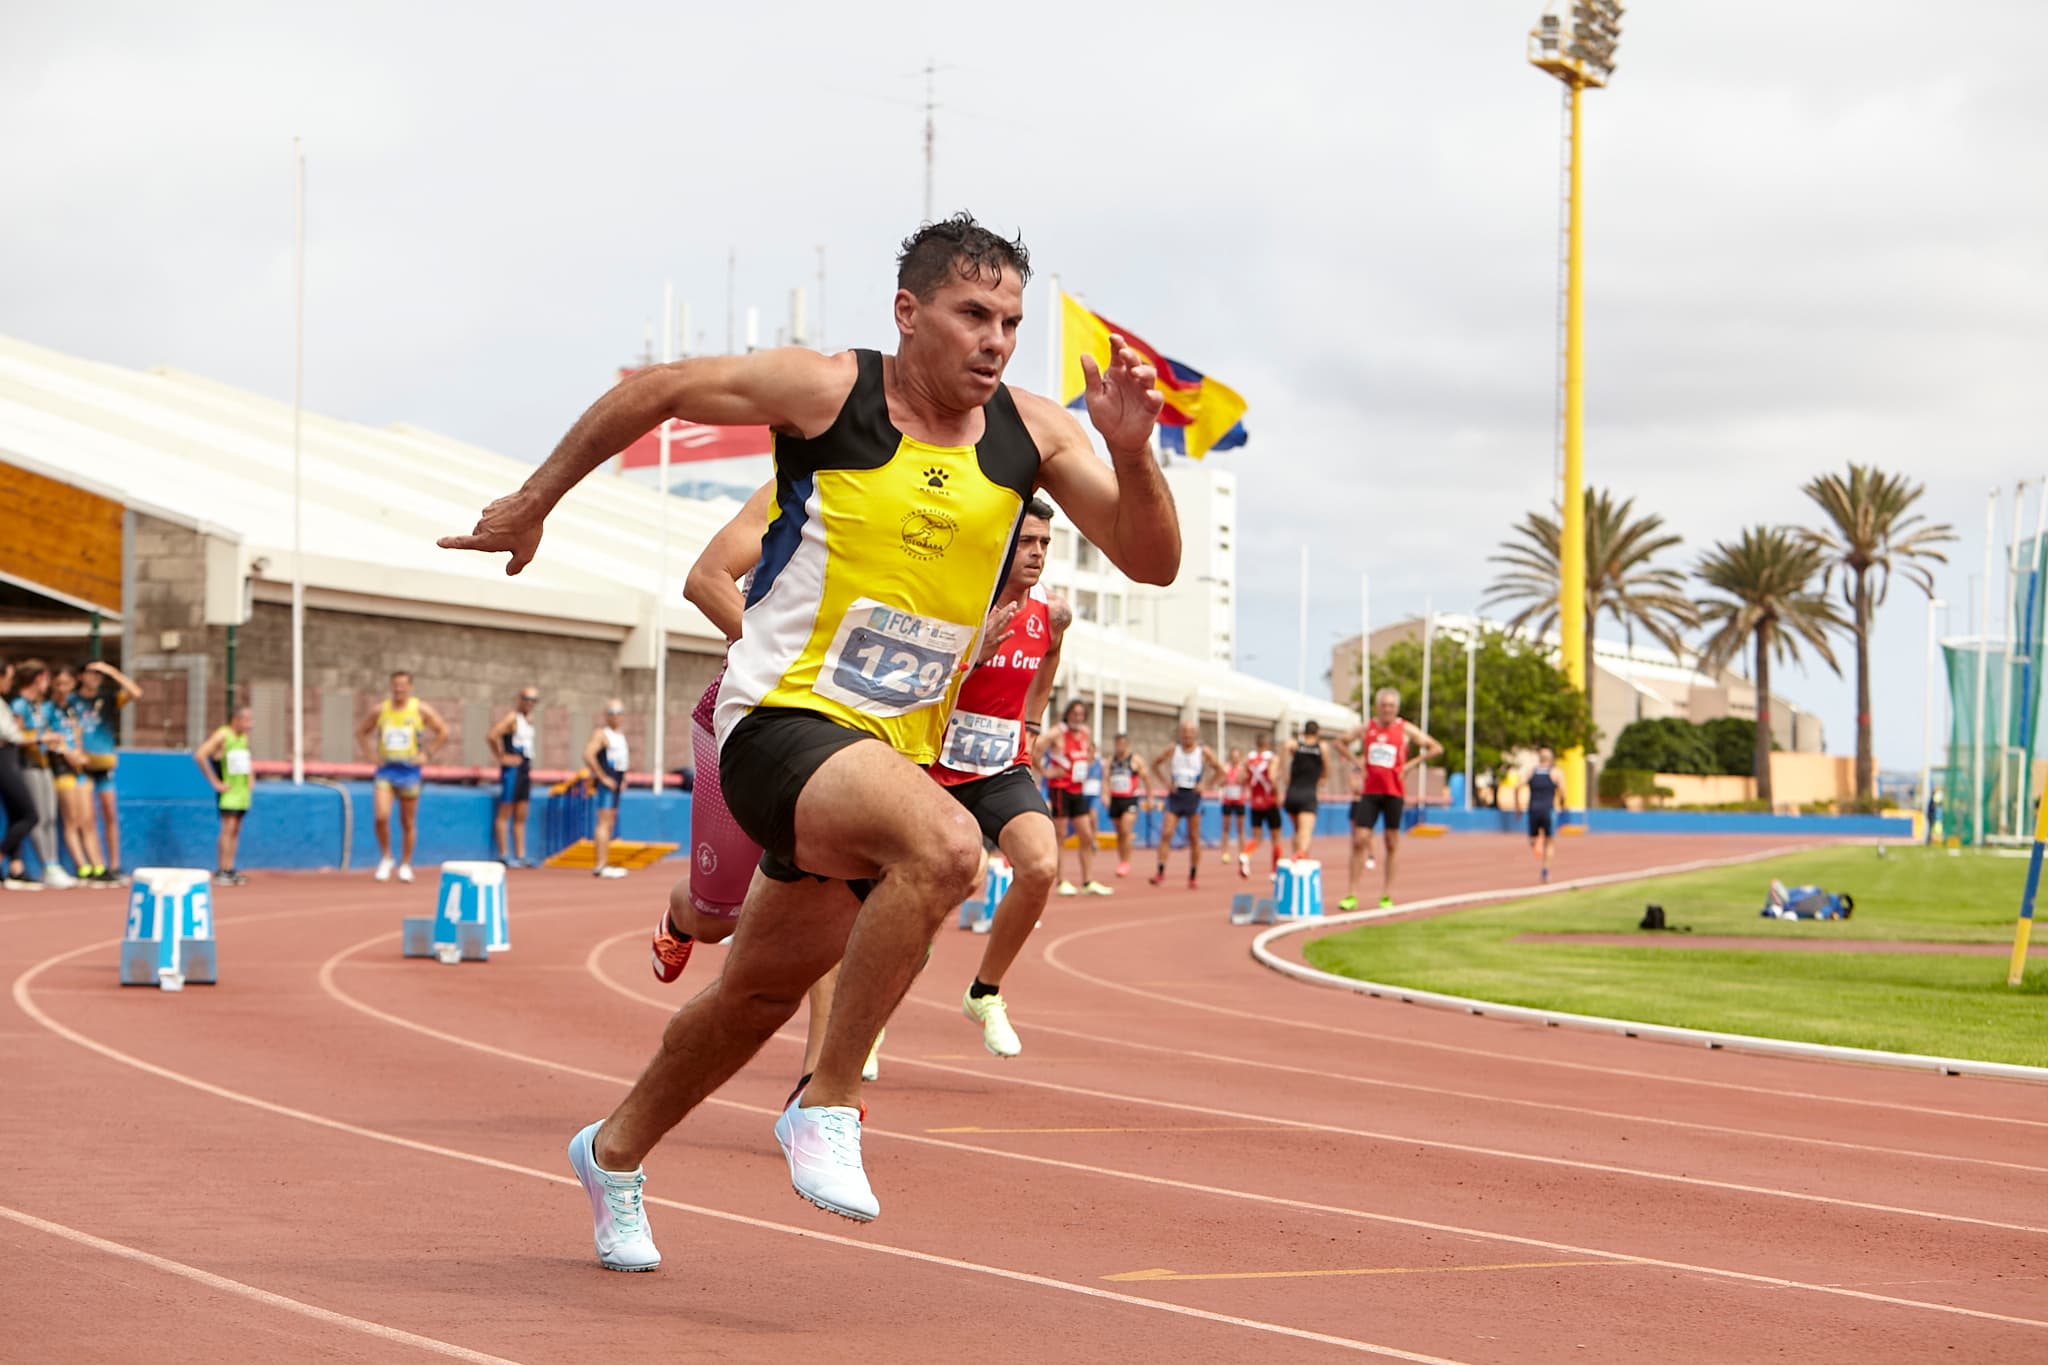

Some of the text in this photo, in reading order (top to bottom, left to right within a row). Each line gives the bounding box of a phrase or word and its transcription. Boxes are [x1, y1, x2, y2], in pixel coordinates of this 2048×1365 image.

[888, 612, 922, 638] FCA
[856, 644, 944, 698] 129
[1011, 649, 1041, 670] Cruz
[974, 715, 992, 729] FCA
[960, 733, 1010, 762] 117
[126, 891, 145, 941] 5
[191, 892, 209, 941] 5
[444, 882, 462, 925] 4
